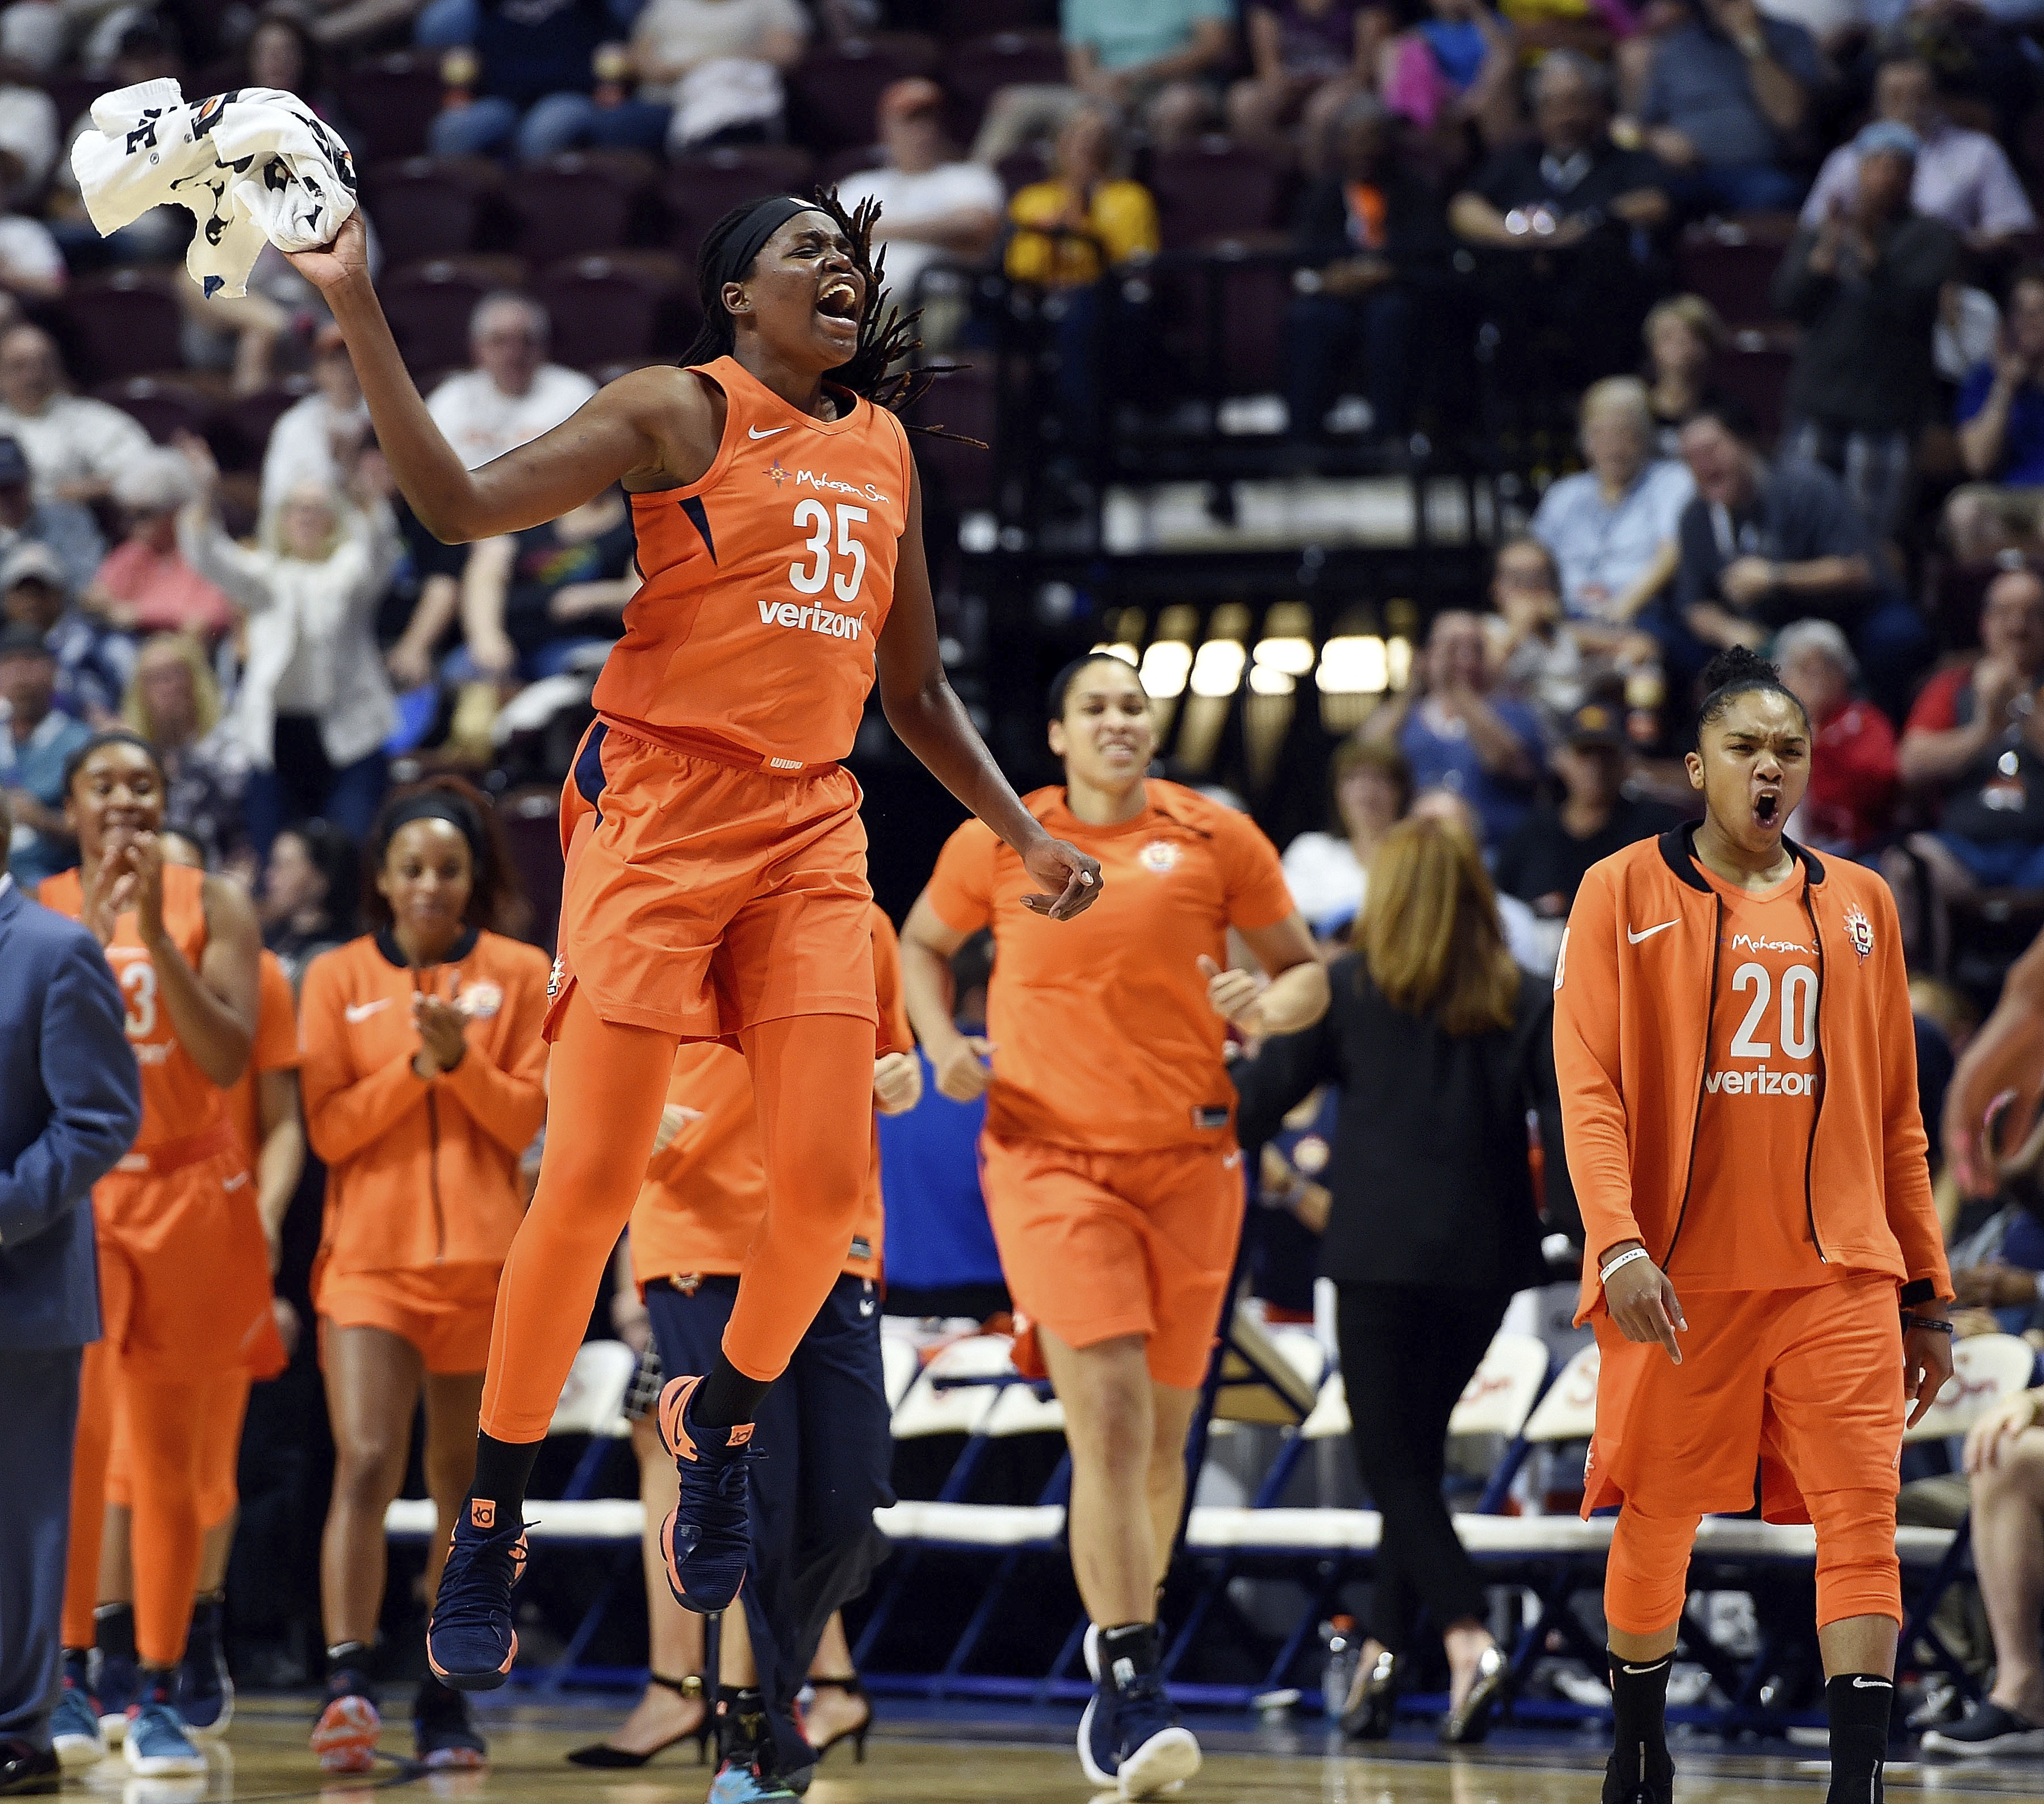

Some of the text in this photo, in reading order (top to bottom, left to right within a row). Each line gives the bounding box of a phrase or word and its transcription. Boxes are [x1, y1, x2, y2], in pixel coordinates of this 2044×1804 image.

[795, 470, 864, 497] Mohegan
[789, 498, 868, 602] 35
[757, 600, 859, 641] verizon
[1731, 934, 1809, 954] Mohegan
[1730, 962, 1819, 1060] 20
